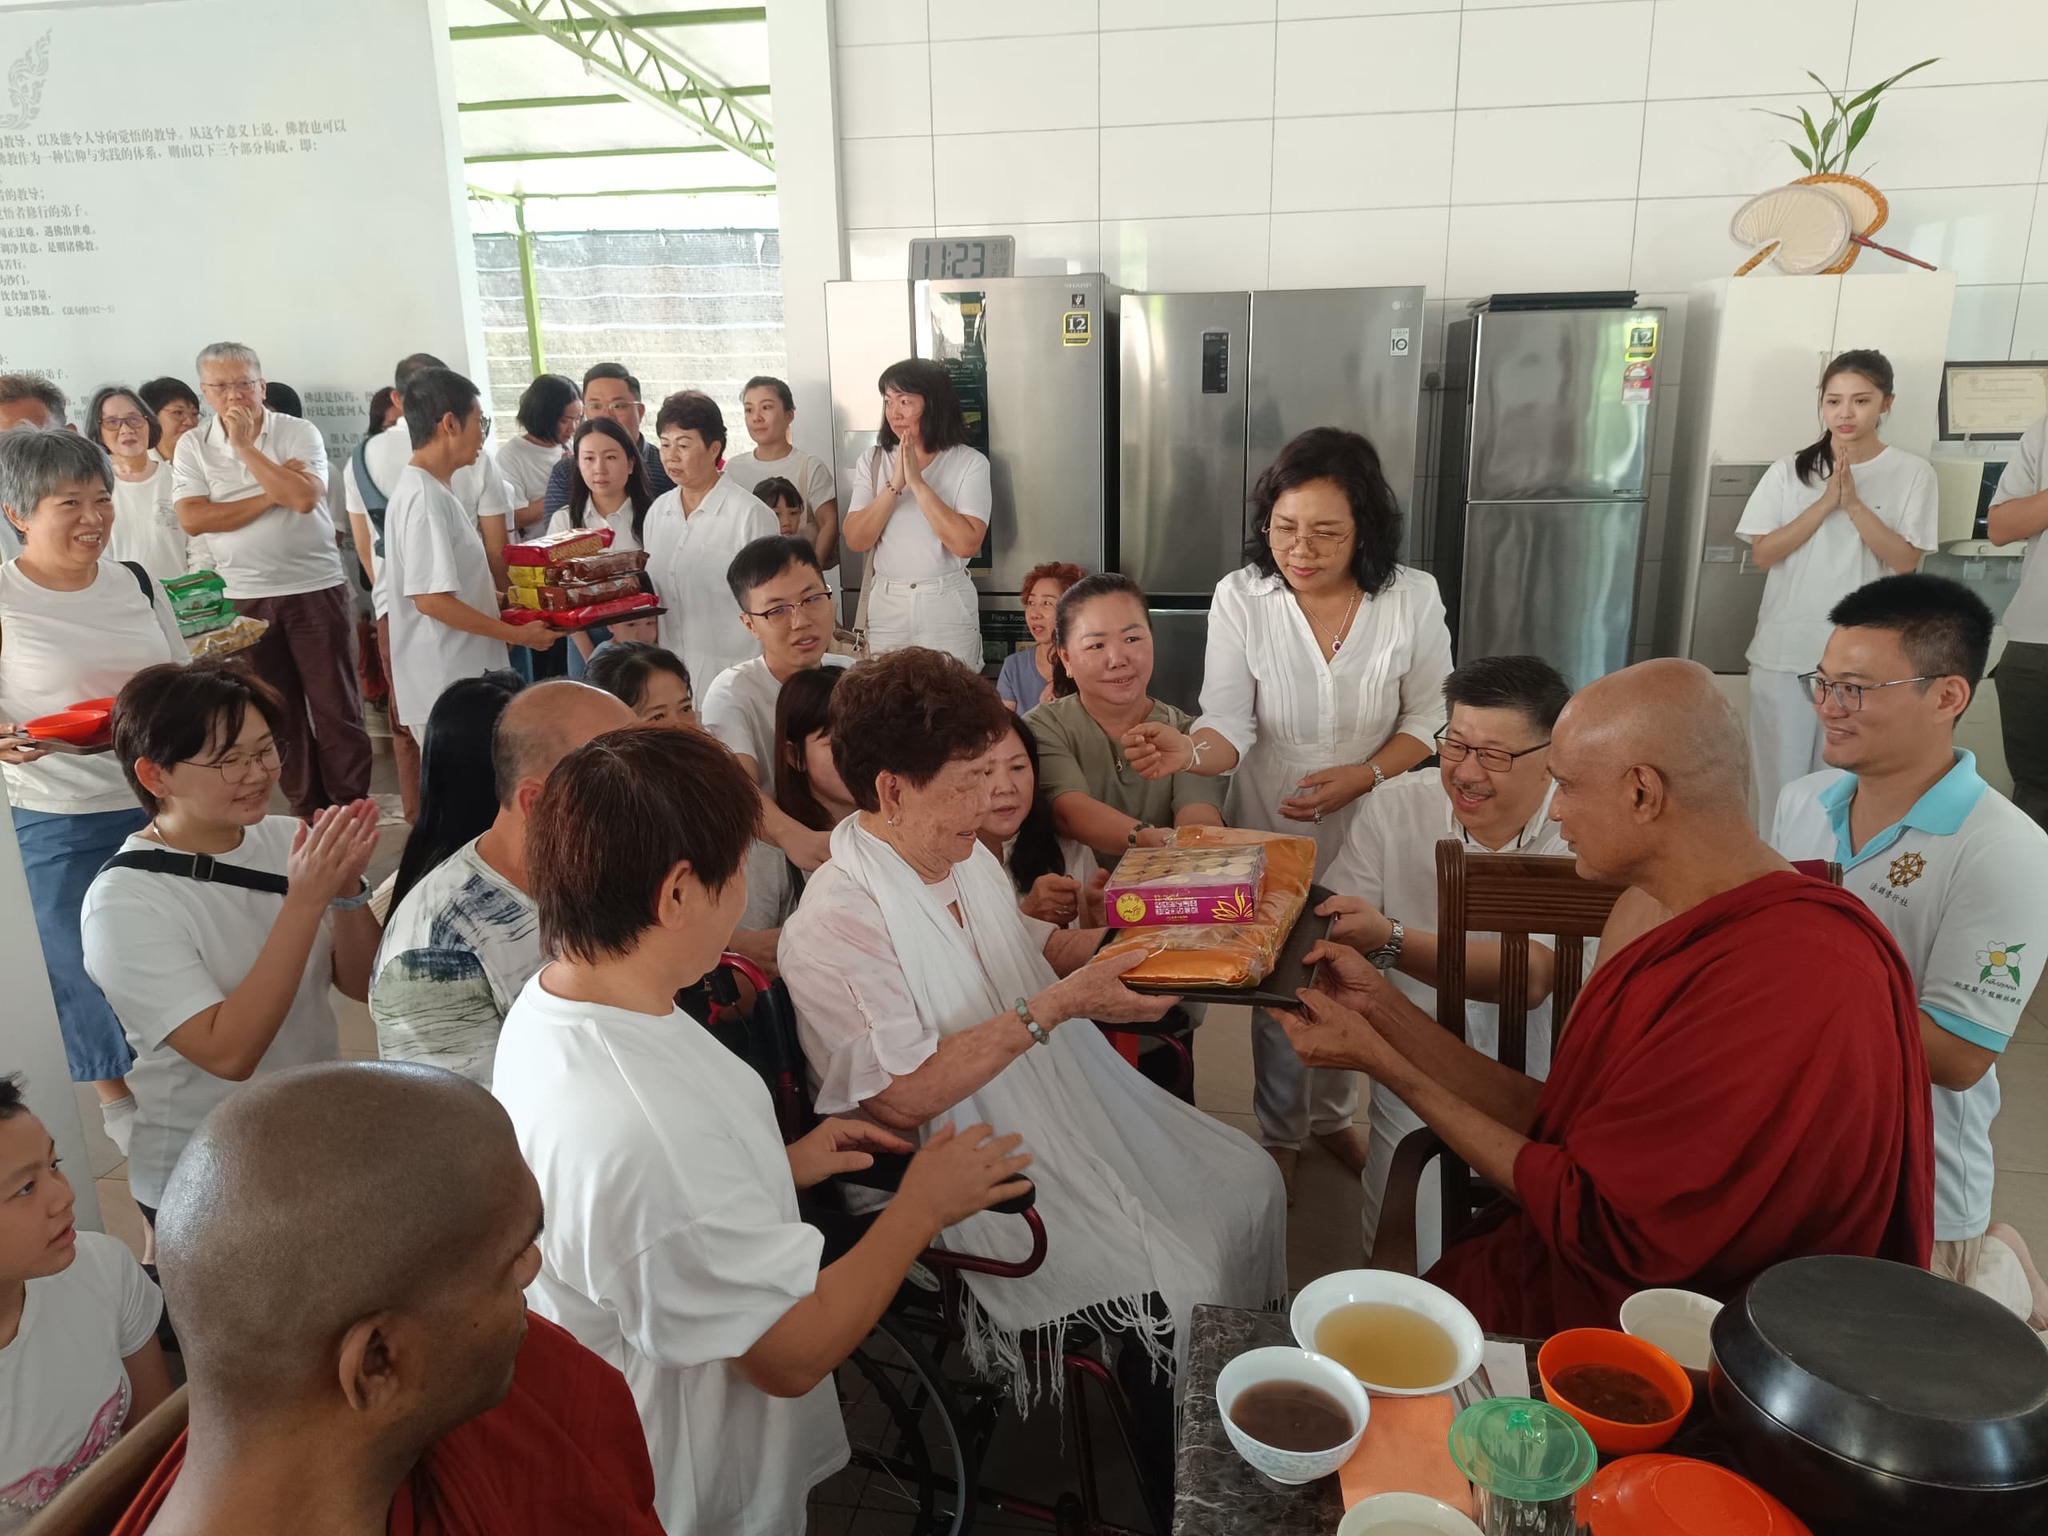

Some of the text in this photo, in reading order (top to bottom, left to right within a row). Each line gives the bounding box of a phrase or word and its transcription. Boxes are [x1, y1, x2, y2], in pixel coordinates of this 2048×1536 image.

[924, 242, 985, 279] 11:23
[1068, 317, 1087, 330] 12
[1632, 331, 1653, 344] 12
[1391, 338, 1408, 351] 10
